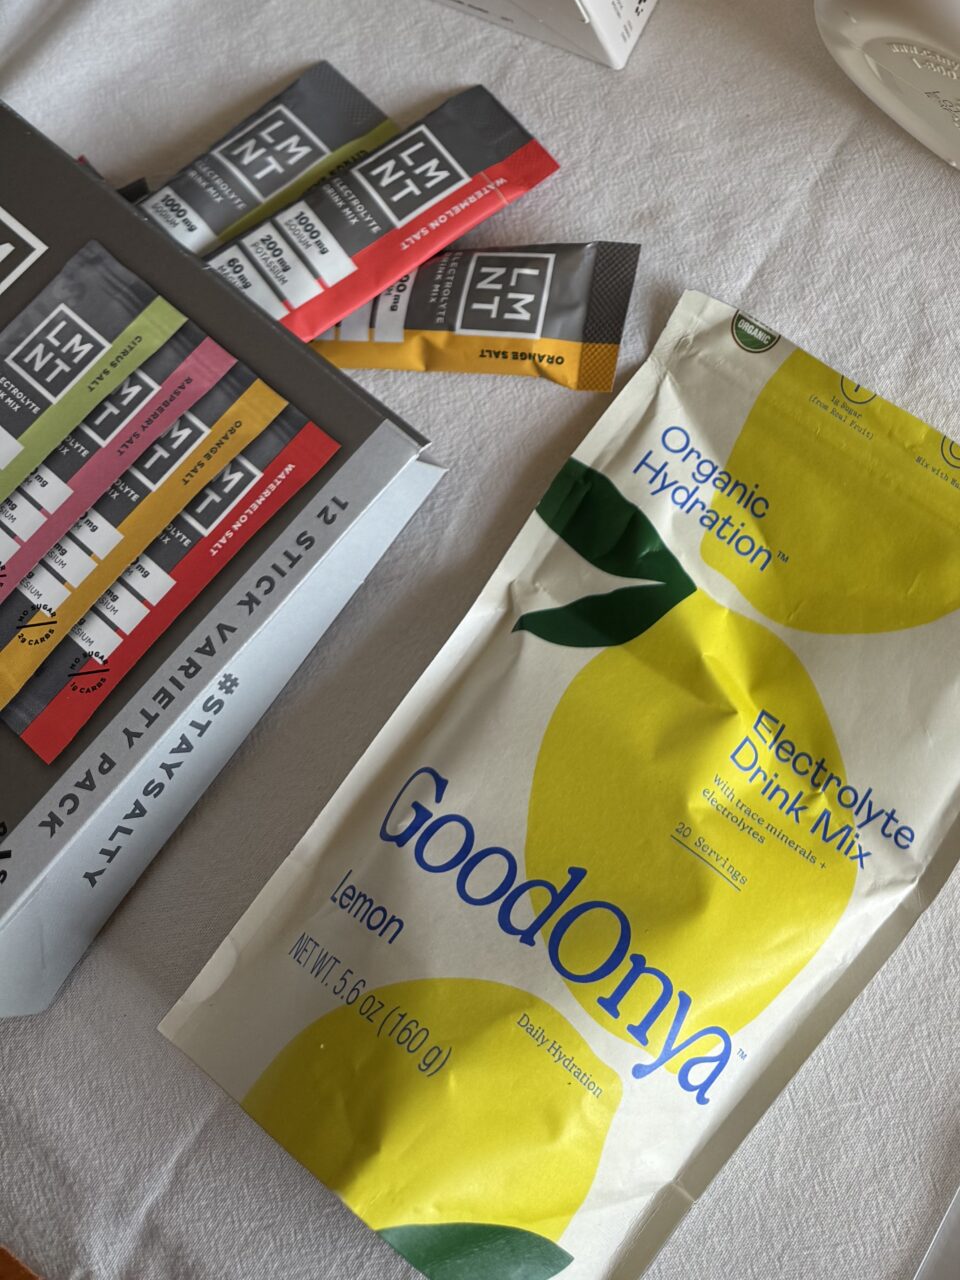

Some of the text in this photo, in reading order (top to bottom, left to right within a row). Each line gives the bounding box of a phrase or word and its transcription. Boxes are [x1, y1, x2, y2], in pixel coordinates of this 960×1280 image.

[322, 183, 361, 227] DRINK MIX
[332, 176, 382, 234] ELECTROLYTE
[401, 176, 508, 251] WATERMELON SALT
[250, 242, 289, 287] POTASSIUM
[86, 335, 143, 393] CITRUS SALT
[479, 348, 565, 366] ORANGE SALT
[737, 318, 772, 345] ORGANIC
[115, 375, 193, 457] RASPBERRY SALT
[181, 419, 243, 487] ORANGE SALT
[208, 463, 297, 558] WATERMELON SALT
[661, 425, 770, 519] Organic
[37, 494, 351, 840] 12 STICK VARIETY PACK
[81, 672, 240, 890] #STAYSALTY
[701, 787, 767, 846] electrolytes
[729, 735, 873, 870] Drink Mix
[752, 708, 916, 851] Electrolyte
[674, 821, 750, 887] 20 Servings
[713, 772, 818, 866] with trace minerals
[329, 868, 406, 945] Lemon
[288, 931, 454, 1079] NET WT. 5.6 oz (160 g)
[516, 1012, 604, 1100] Daily Hydration
